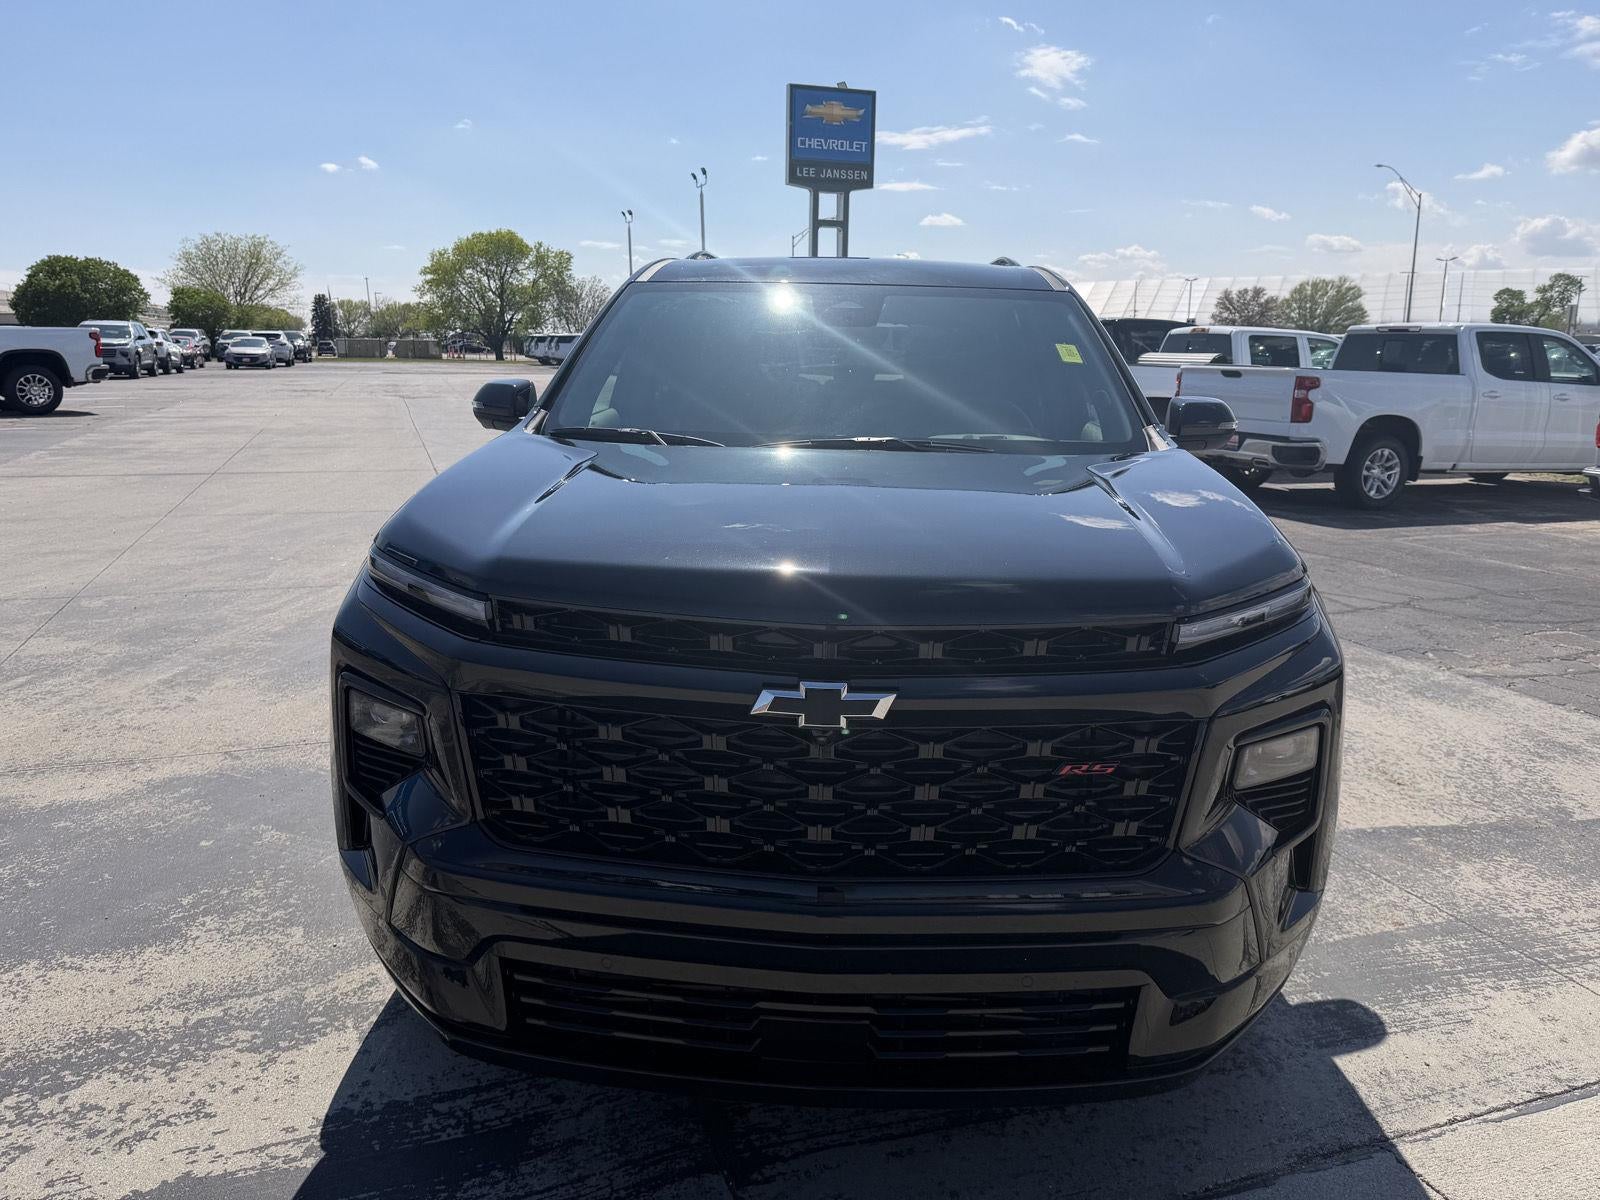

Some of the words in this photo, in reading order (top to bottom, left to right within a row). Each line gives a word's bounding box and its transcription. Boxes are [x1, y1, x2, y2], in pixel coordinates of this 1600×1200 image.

[797, 137, 868, 152] CHEVROLET
[797, 167, 816, 177] LEE
[820, 169, 868, 180] JANSSEN
[1059, 763, 1118, 775] RS
